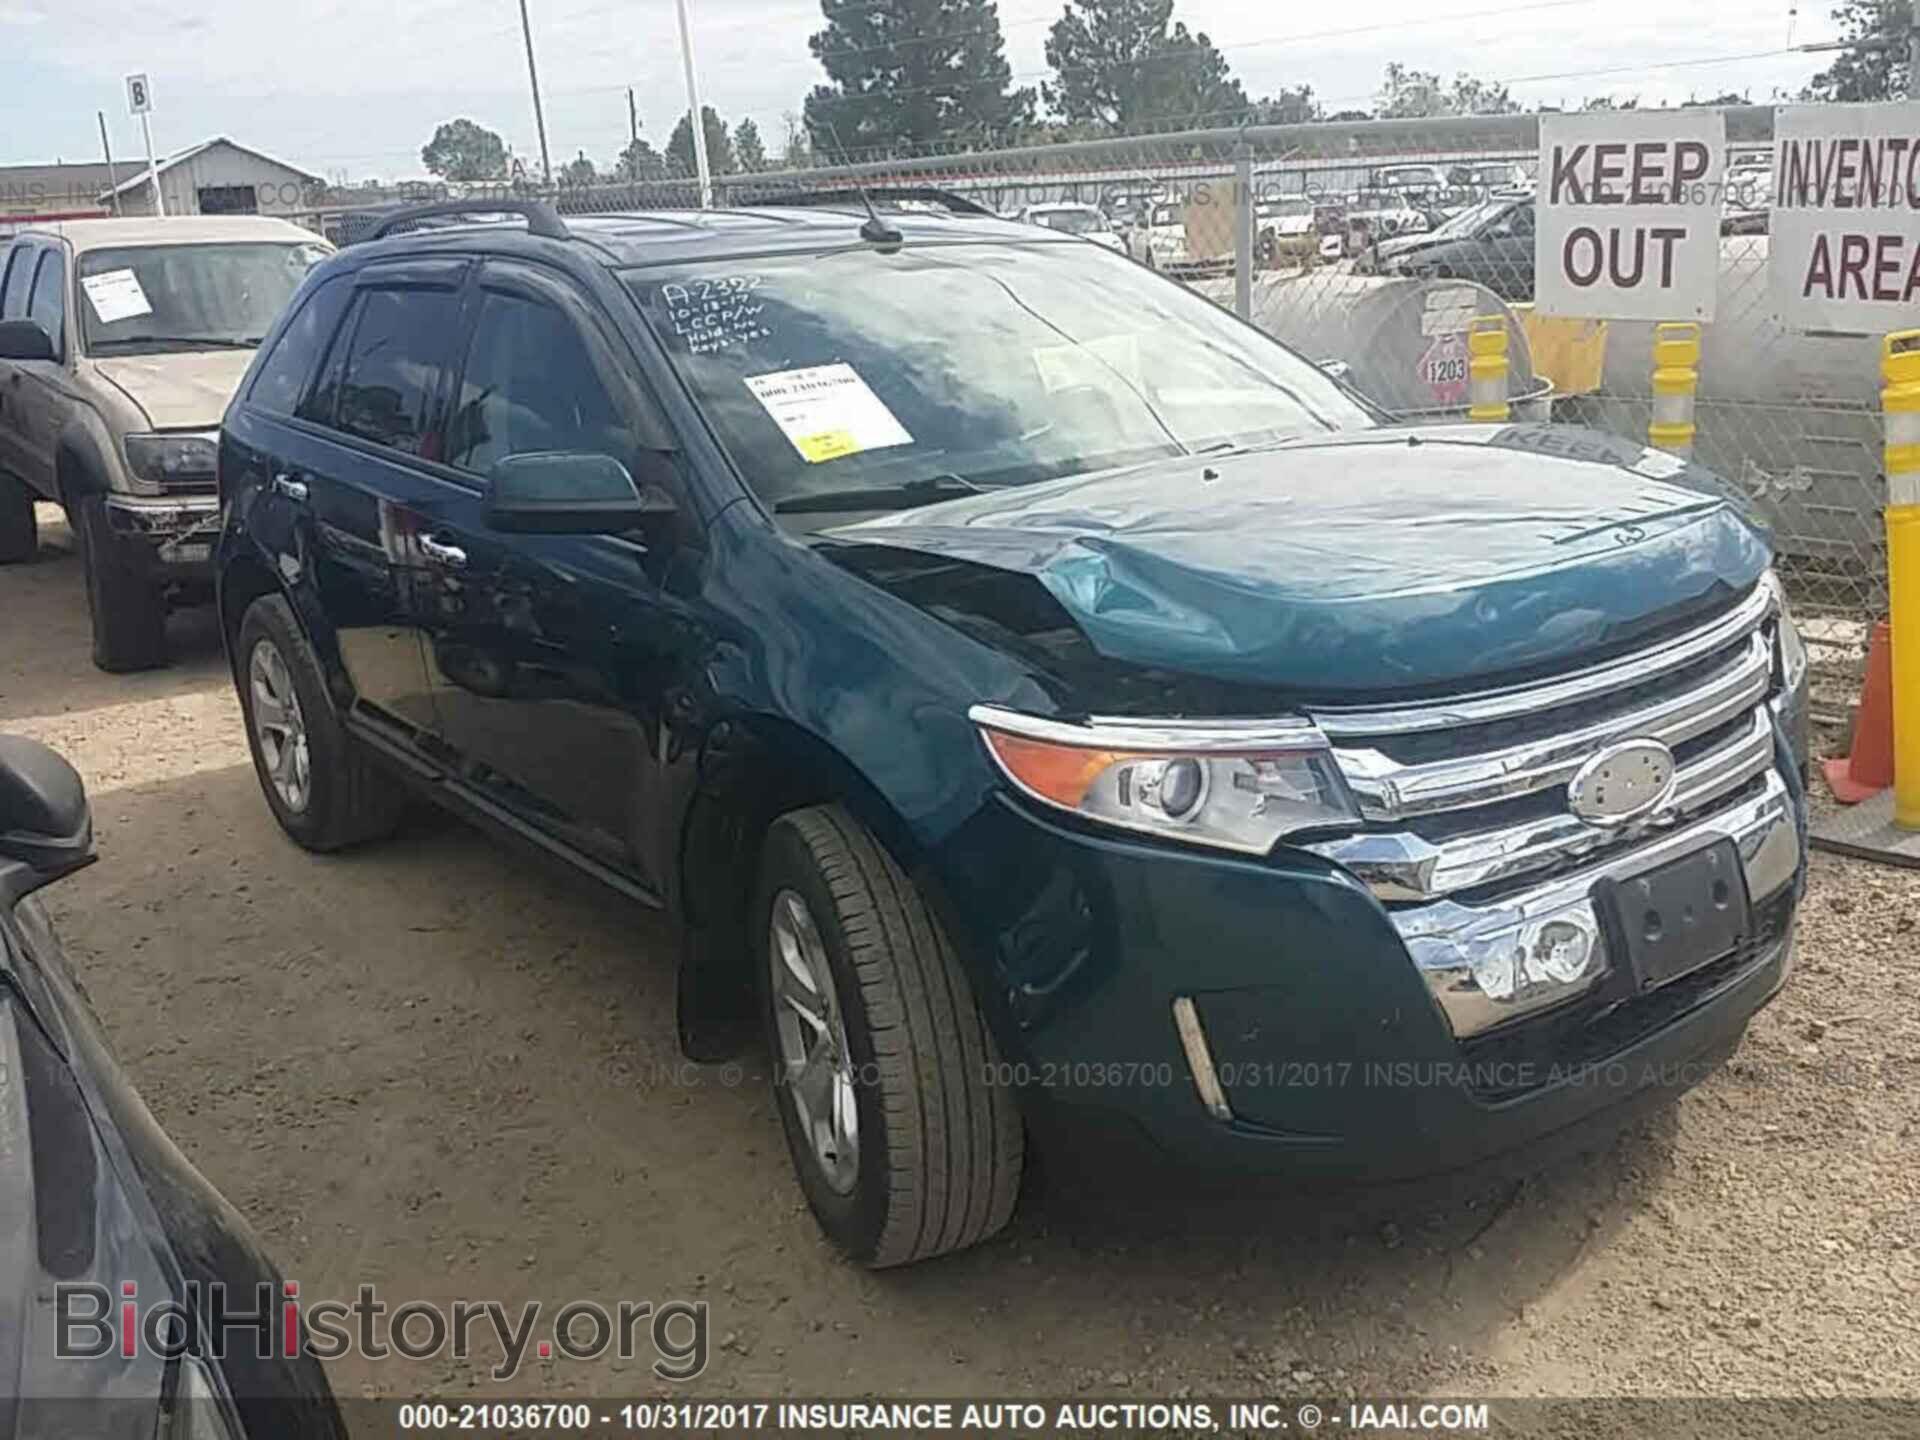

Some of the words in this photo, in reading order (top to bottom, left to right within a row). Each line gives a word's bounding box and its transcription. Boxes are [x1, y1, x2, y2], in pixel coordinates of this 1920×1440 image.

[131, 81, 146, 106] B
[1549, 141, 1710, 206] KEEP
[1562, 227, 1687, 289] OUT
[1429, 359, 1466, 382] 1203
